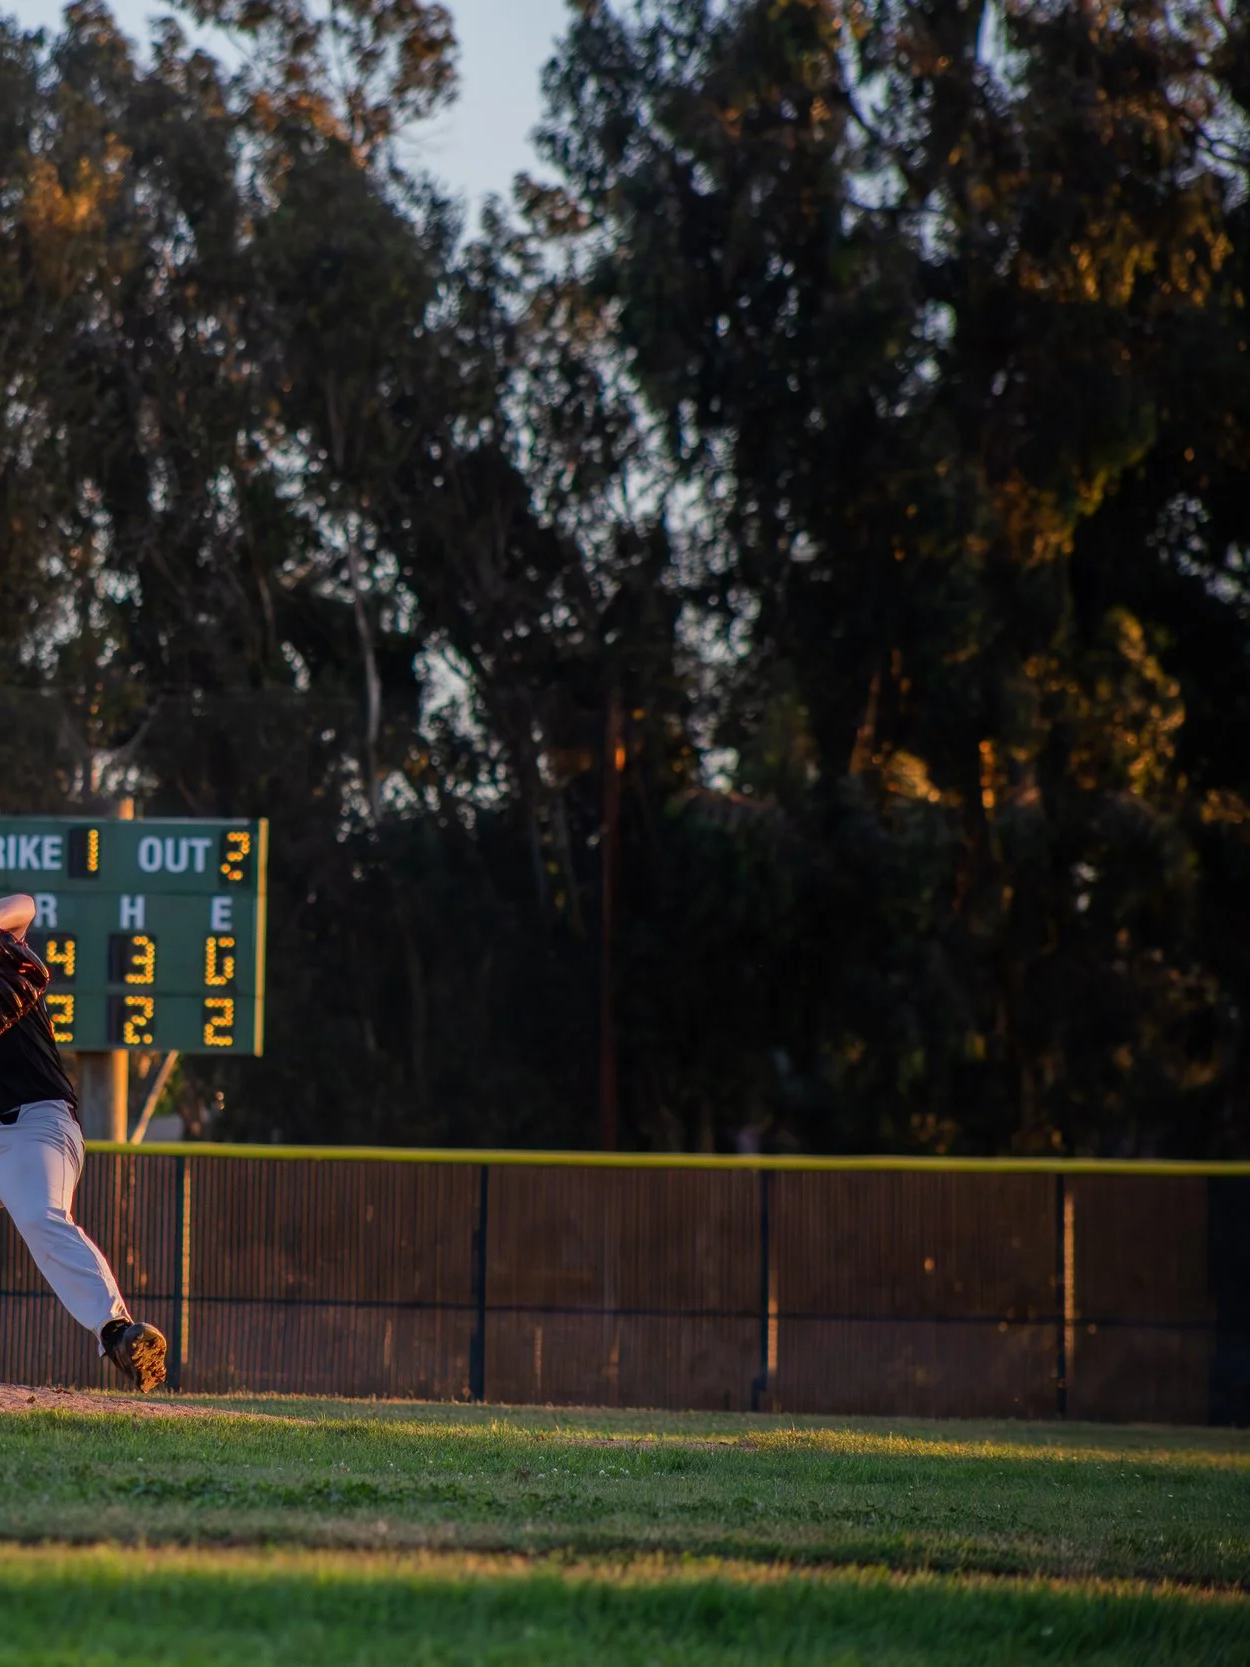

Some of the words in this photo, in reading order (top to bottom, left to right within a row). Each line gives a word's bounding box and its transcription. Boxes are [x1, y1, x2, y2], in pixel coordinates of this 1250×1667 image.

[88, 829, 98, 872] 1
[138, 837, 212, 873] OUT
[34, 893, 58, 928] R
[119, 895, 145, 929] H
[211, 896, 232, 931] E
[47, 941, 75, 976] 4
[126, 936, 155, 984] 3
[46, 995, 74, 1042] 2
[124, 996, 154, 1044] 2
[204, 998, 234, 1046] 2
